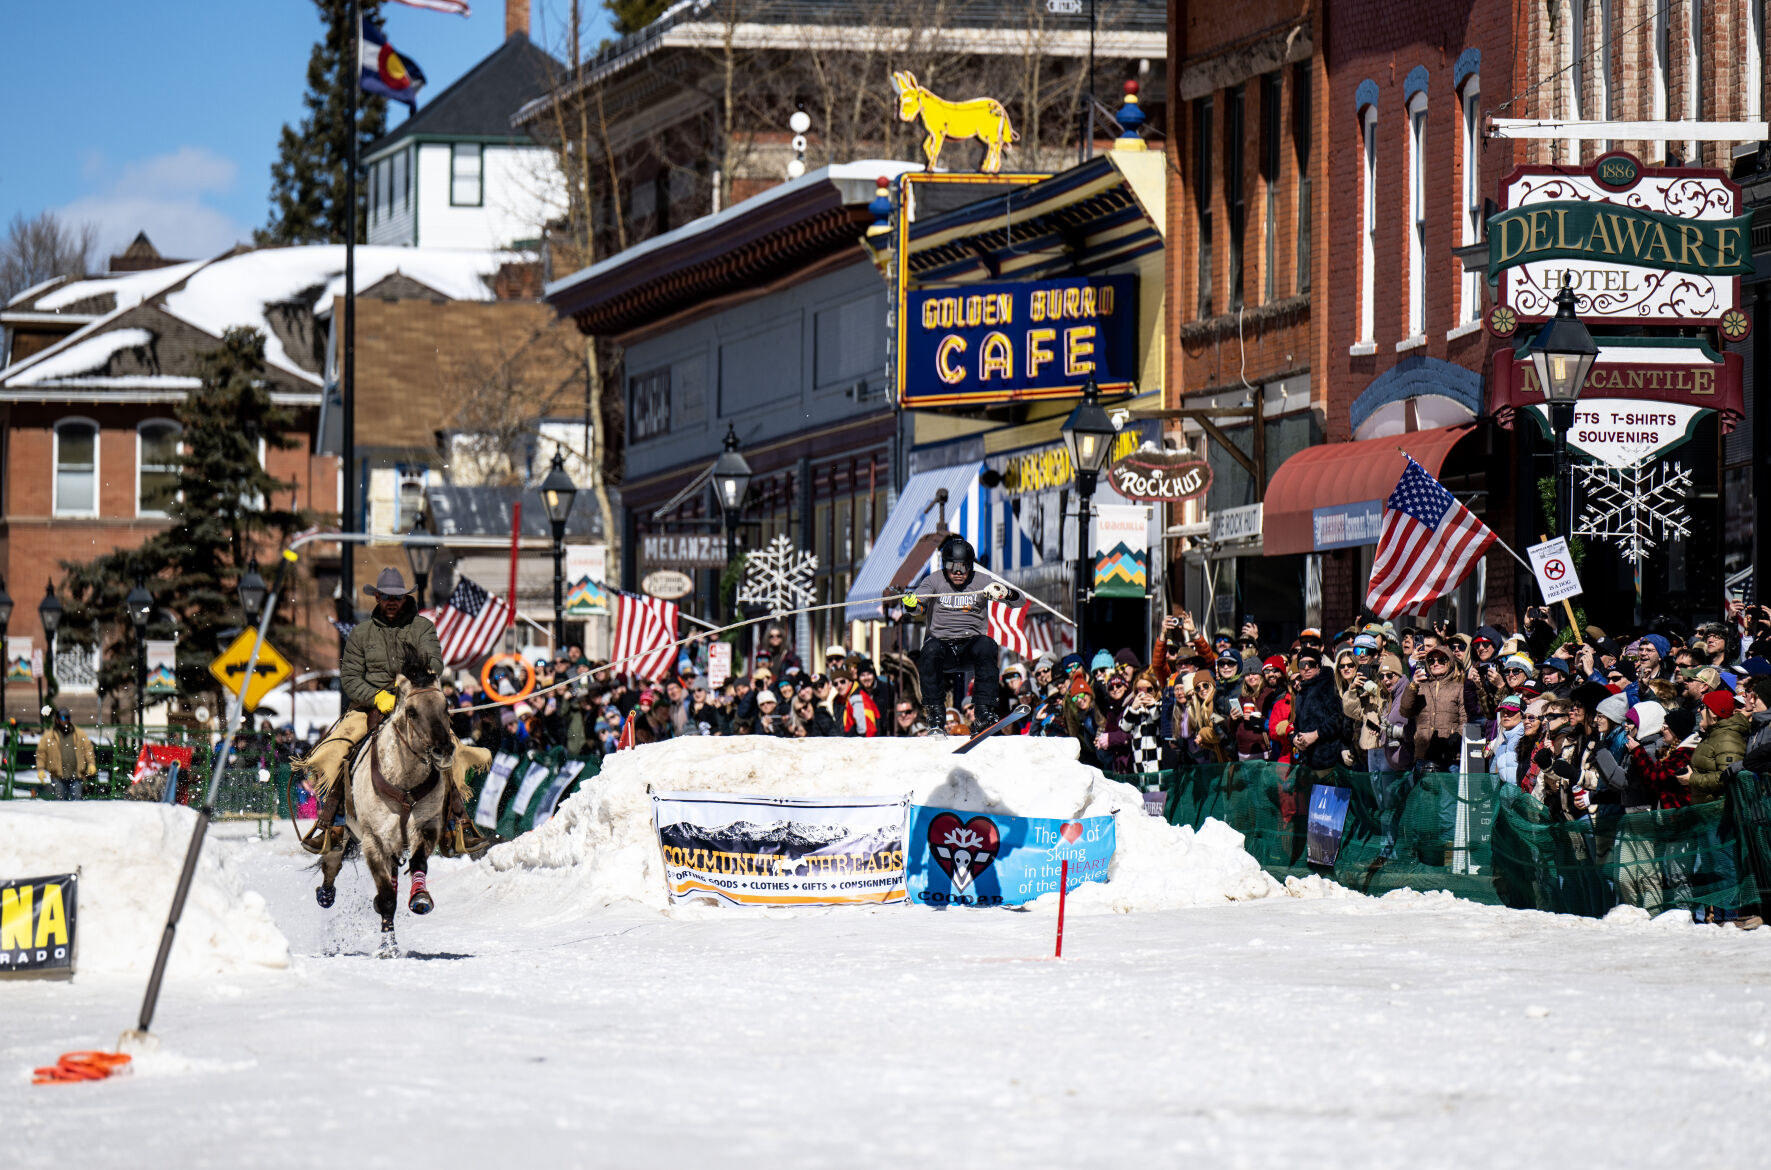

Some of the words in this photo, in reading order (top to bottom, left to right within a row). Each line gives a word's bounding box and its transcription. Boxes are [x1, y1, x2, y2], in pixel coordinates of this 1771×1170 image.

[1602, 163, 1635, 180] 1886
[1497, 209, 1743, 269] DELAWARE
[1542, 269, 1639, 292] HOTEL
[922, 292, 1013, 329] GOLDEN
[1030, 285, 1115, 322] BURRO
[935, 325, 1097, 385] CAFE
[1520, 365, 1716, 395] MCANTILE
[1574, 412, 1600, 424] FTS
[1611, 413, 1677, 426] T-SHIRTS
[1578, 431, 1659, 443] SOUVENIRS
[1226, 512, 1244, 537] ROCK
[1244, 510, 1258, 533] HUT
[1547, 589, 1561, 598] FREE
[1560, 585, 1577, 594] EVENT
[1034, 826, 1057, 844] The
[1086, 825, 1100, 842] of
[663, 844, 790, 877] COMMUNITY
[805, 850, 903, 877] THREADS
[1046, 848, 1086, 862] Skiing
[1024, 864, 1039, 878] in
[1041, 864, 1062, 877] the
[1067, 858, 1107, 874] HEART
[750, 882, 790, 891] CLOTHES
[801, 882, 828, 891] GIFTS
[839, 876, 903, 891] CONSIGNMENT
[1019, 880, 1034, 895] of
[1036, 879, 1057, 892] the
[1064, 869, 1107, 887] Rockies
